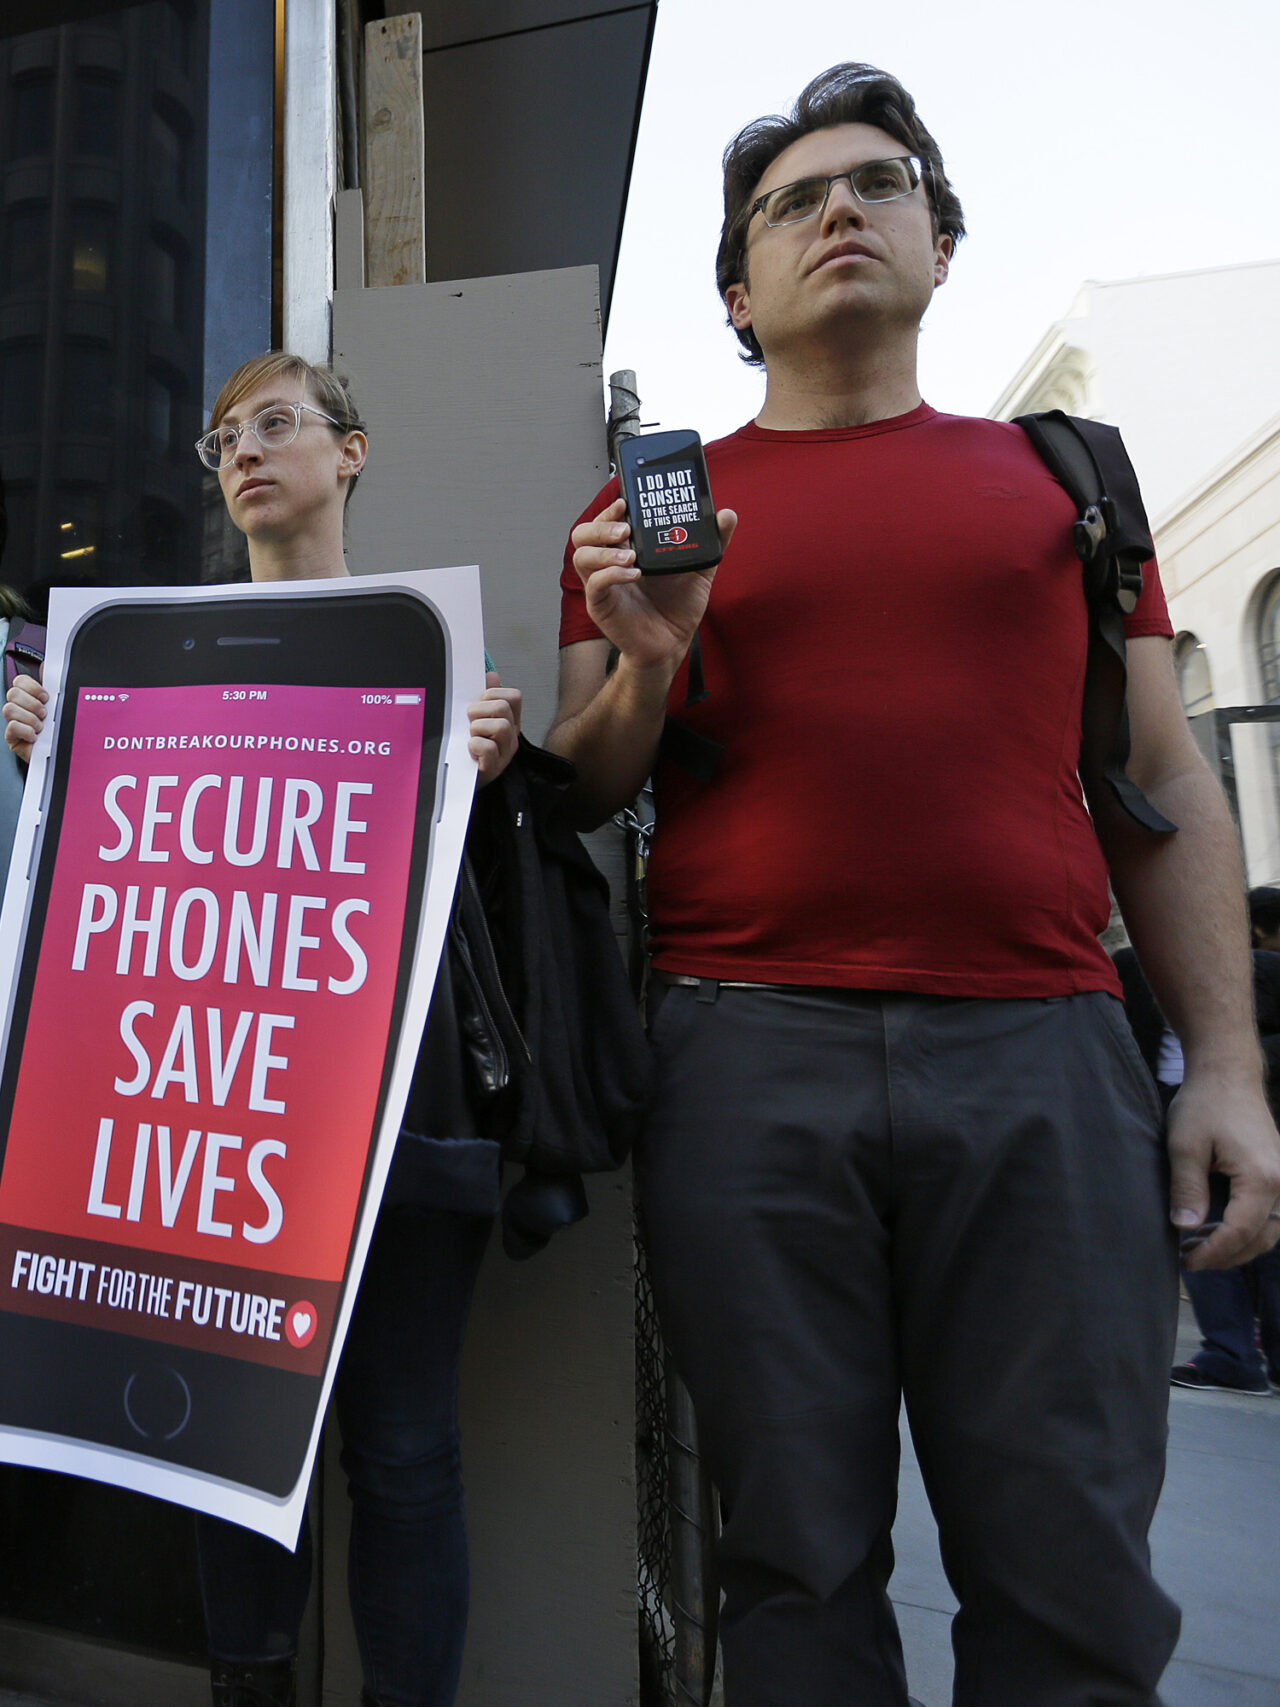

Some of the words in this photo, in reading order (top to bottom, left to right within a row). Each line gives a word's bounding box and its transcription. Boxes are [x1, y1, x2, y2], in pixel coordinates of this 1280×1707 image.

[637, 477, 642, 492] I
[646, 474, 664, 490] DO
[667, 470, 692, 487] NOT
[640, 486, 696, 508] CONSENT
[642, 509, 651, 518] TO
[653, 507, 667, 516] THE
[669, 502, 698, 514] SEARCH
[644, 519, 652, 528] OF
[654, 516, 670, 526] THIS
[672, 512, 700, 524] DEVICE.
[222, 690, 246, 700] 5:30
[248, 690, 267, 700] PM
[360, 694, 392, 705] 100%
[104, 735, 392, 756] DONTBREAKOURPHONES.ORG
[98, 772, 373, 876] SECURE
[71, 883, 370, 996] PHONES
[113, 1000, 297, 1116] SAVE
[86, 1116, 287, 1245] LIVES
[11, 1250, 96, 1301] FIGHT
[175, 1281, 286, 1341] FUTURE
